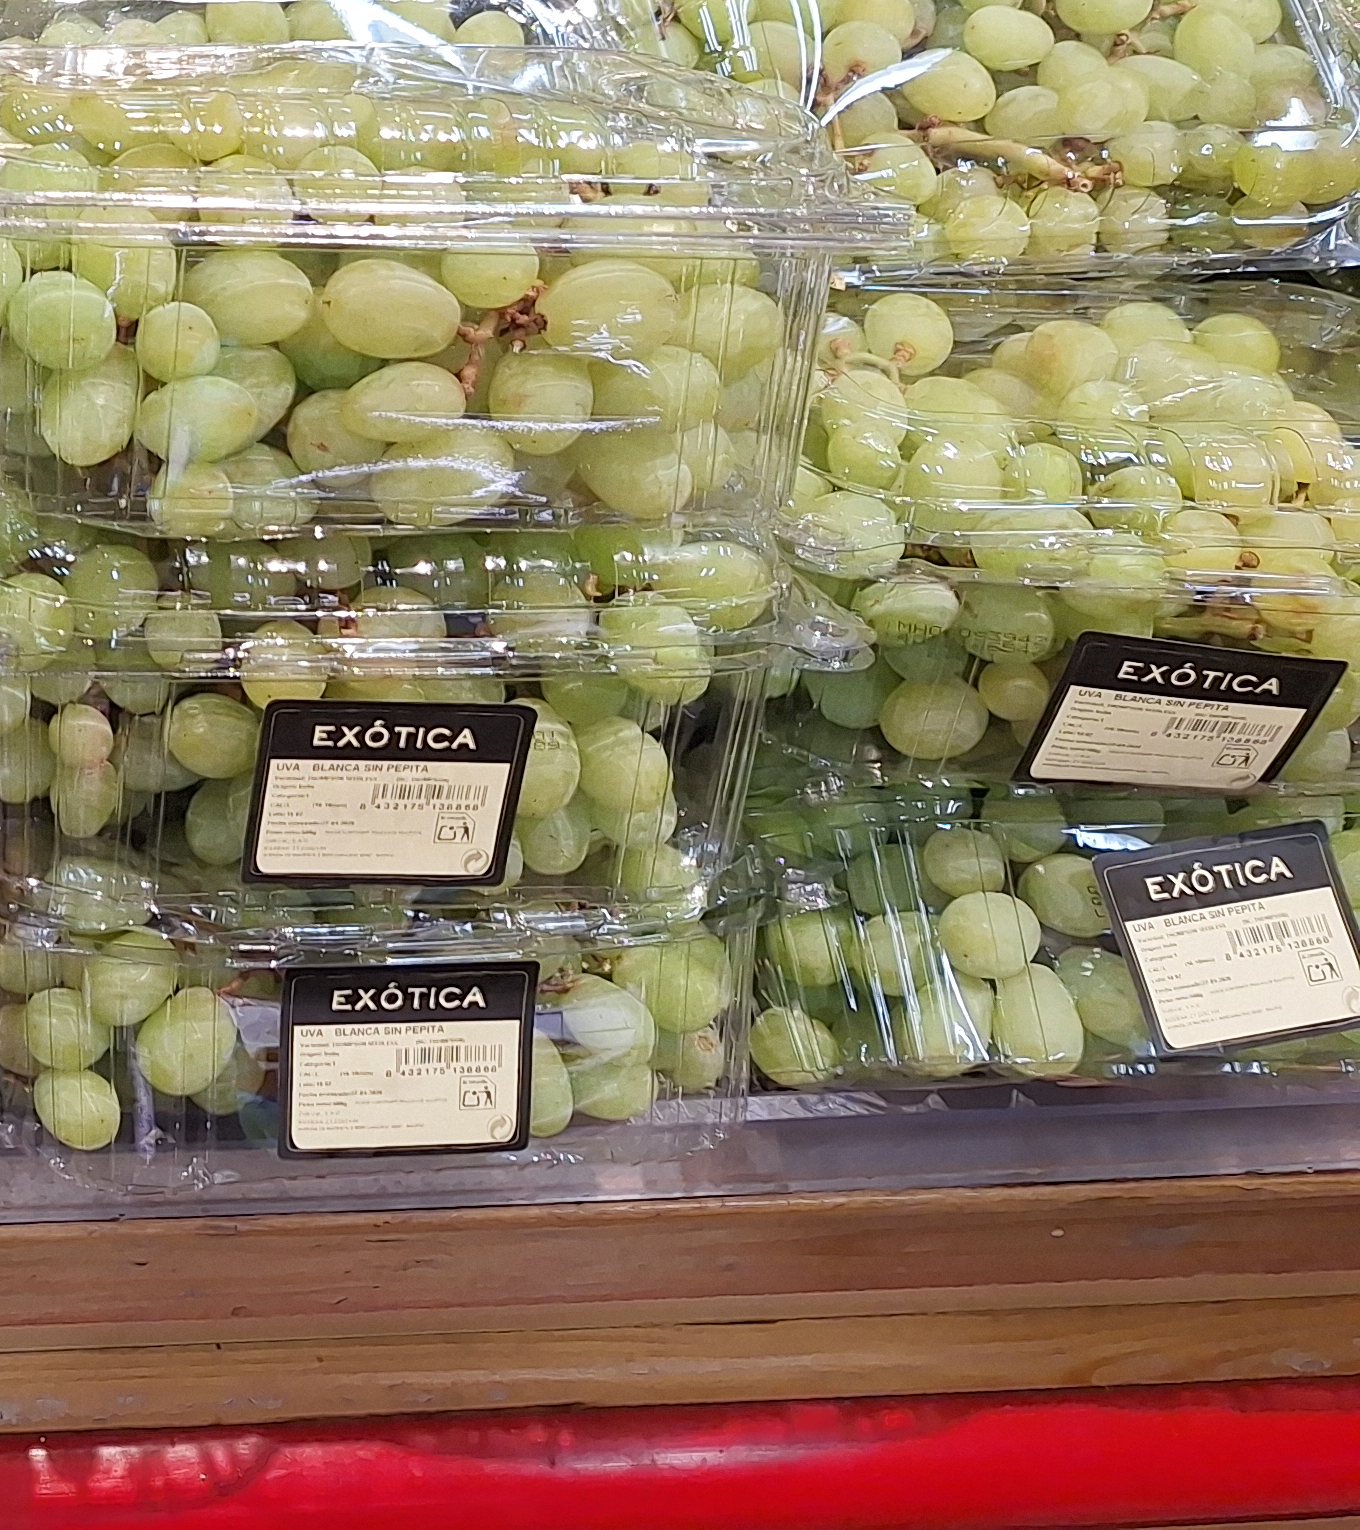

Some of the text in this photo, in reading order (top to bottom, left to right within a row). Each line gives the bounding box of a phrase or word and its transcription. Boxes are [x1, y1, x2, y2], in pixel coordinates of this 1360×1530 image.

[1117, 660, 1280, 696] EXÓTICA
[1078, 689, 1230, 712] UVA BLANCA SIN PEPITA
[312, 720, 476, 750] EXÓTICA
[276, 763, 429, 773] UVA BLANCA SIN PEPITA
[1144, 856, 1294, 901] EXÓTICA
[1133, 902, 1266, 933] UVA BLANCA SIN PEPITA
[331, 982, 487, 1011] EXÓTICA
[301, 1025, 445, 1038] UVA BLANCA SIN PEPITA
